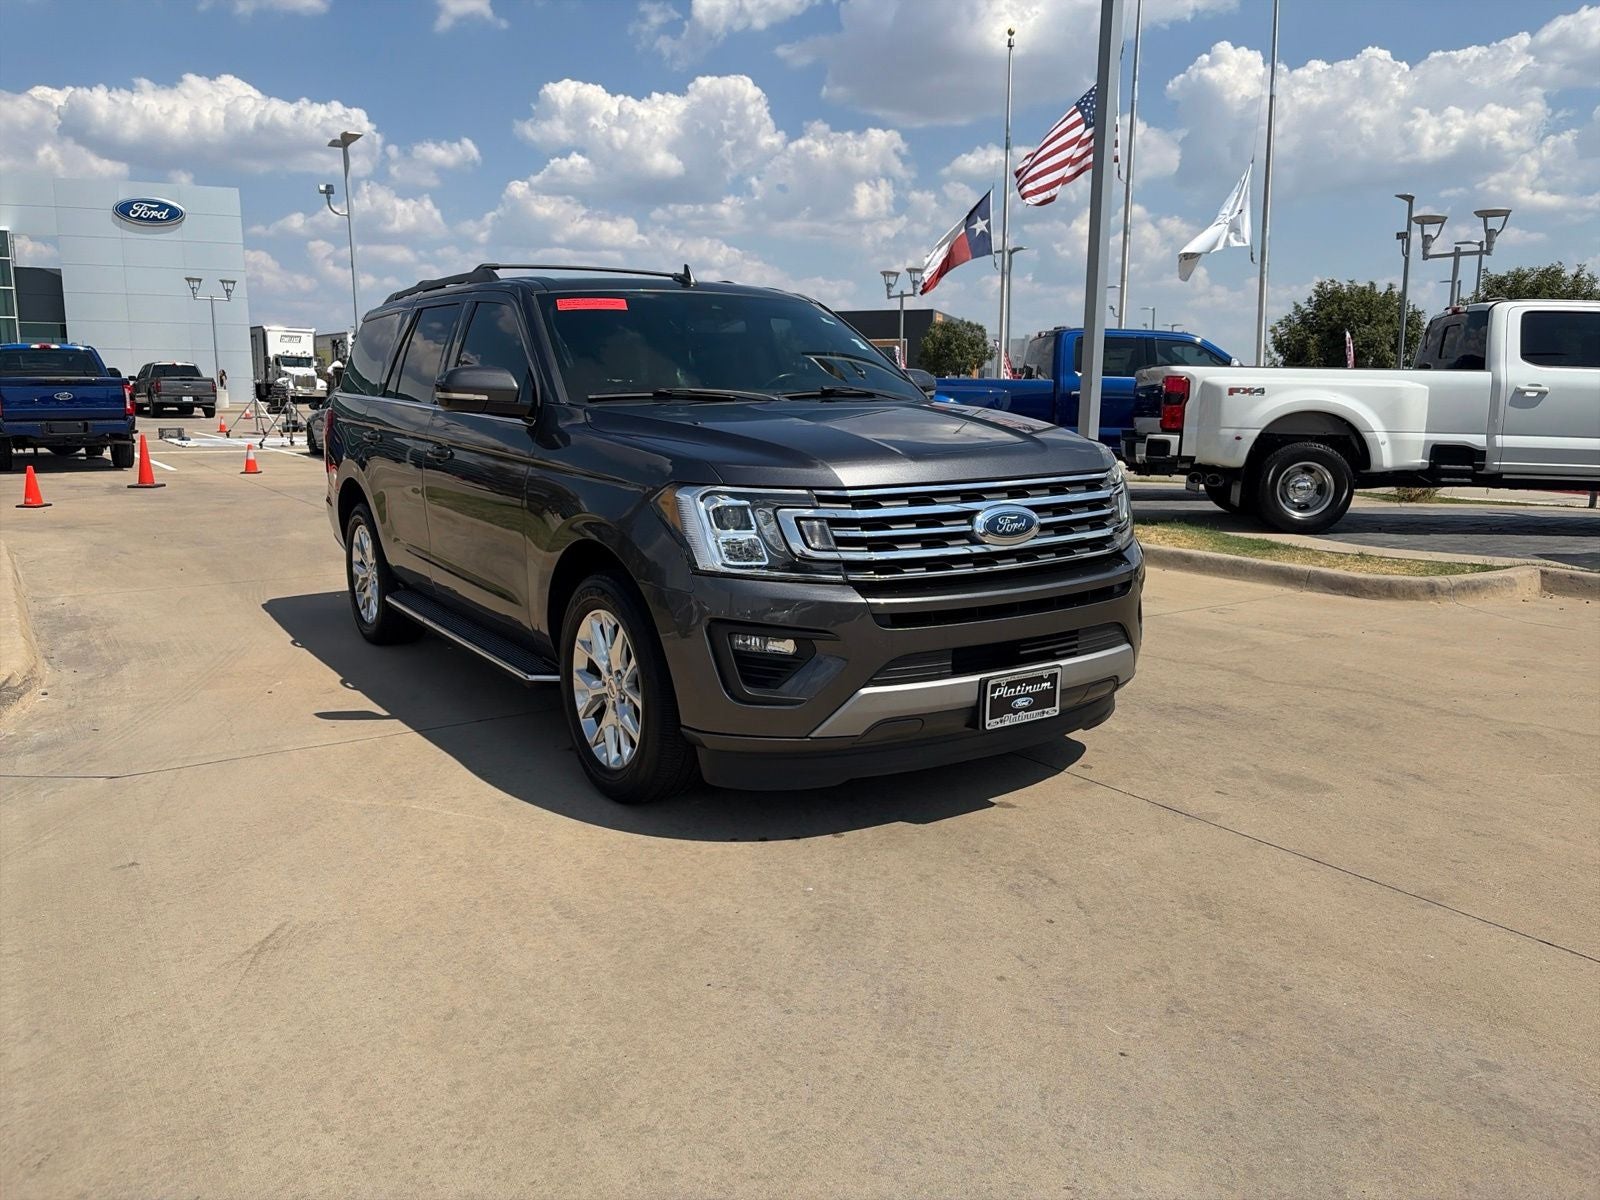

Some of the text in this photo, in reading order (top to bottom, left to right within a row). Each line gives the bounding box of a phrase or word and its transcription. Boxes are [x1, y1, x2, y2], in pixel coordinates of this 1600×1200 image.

[129, 202, 170, 220] Ford
[1228, 387, 1265, 396] FX4
[997, 515, 1027, 533] Ford
[990, 681, 1054, 699] Platinum
